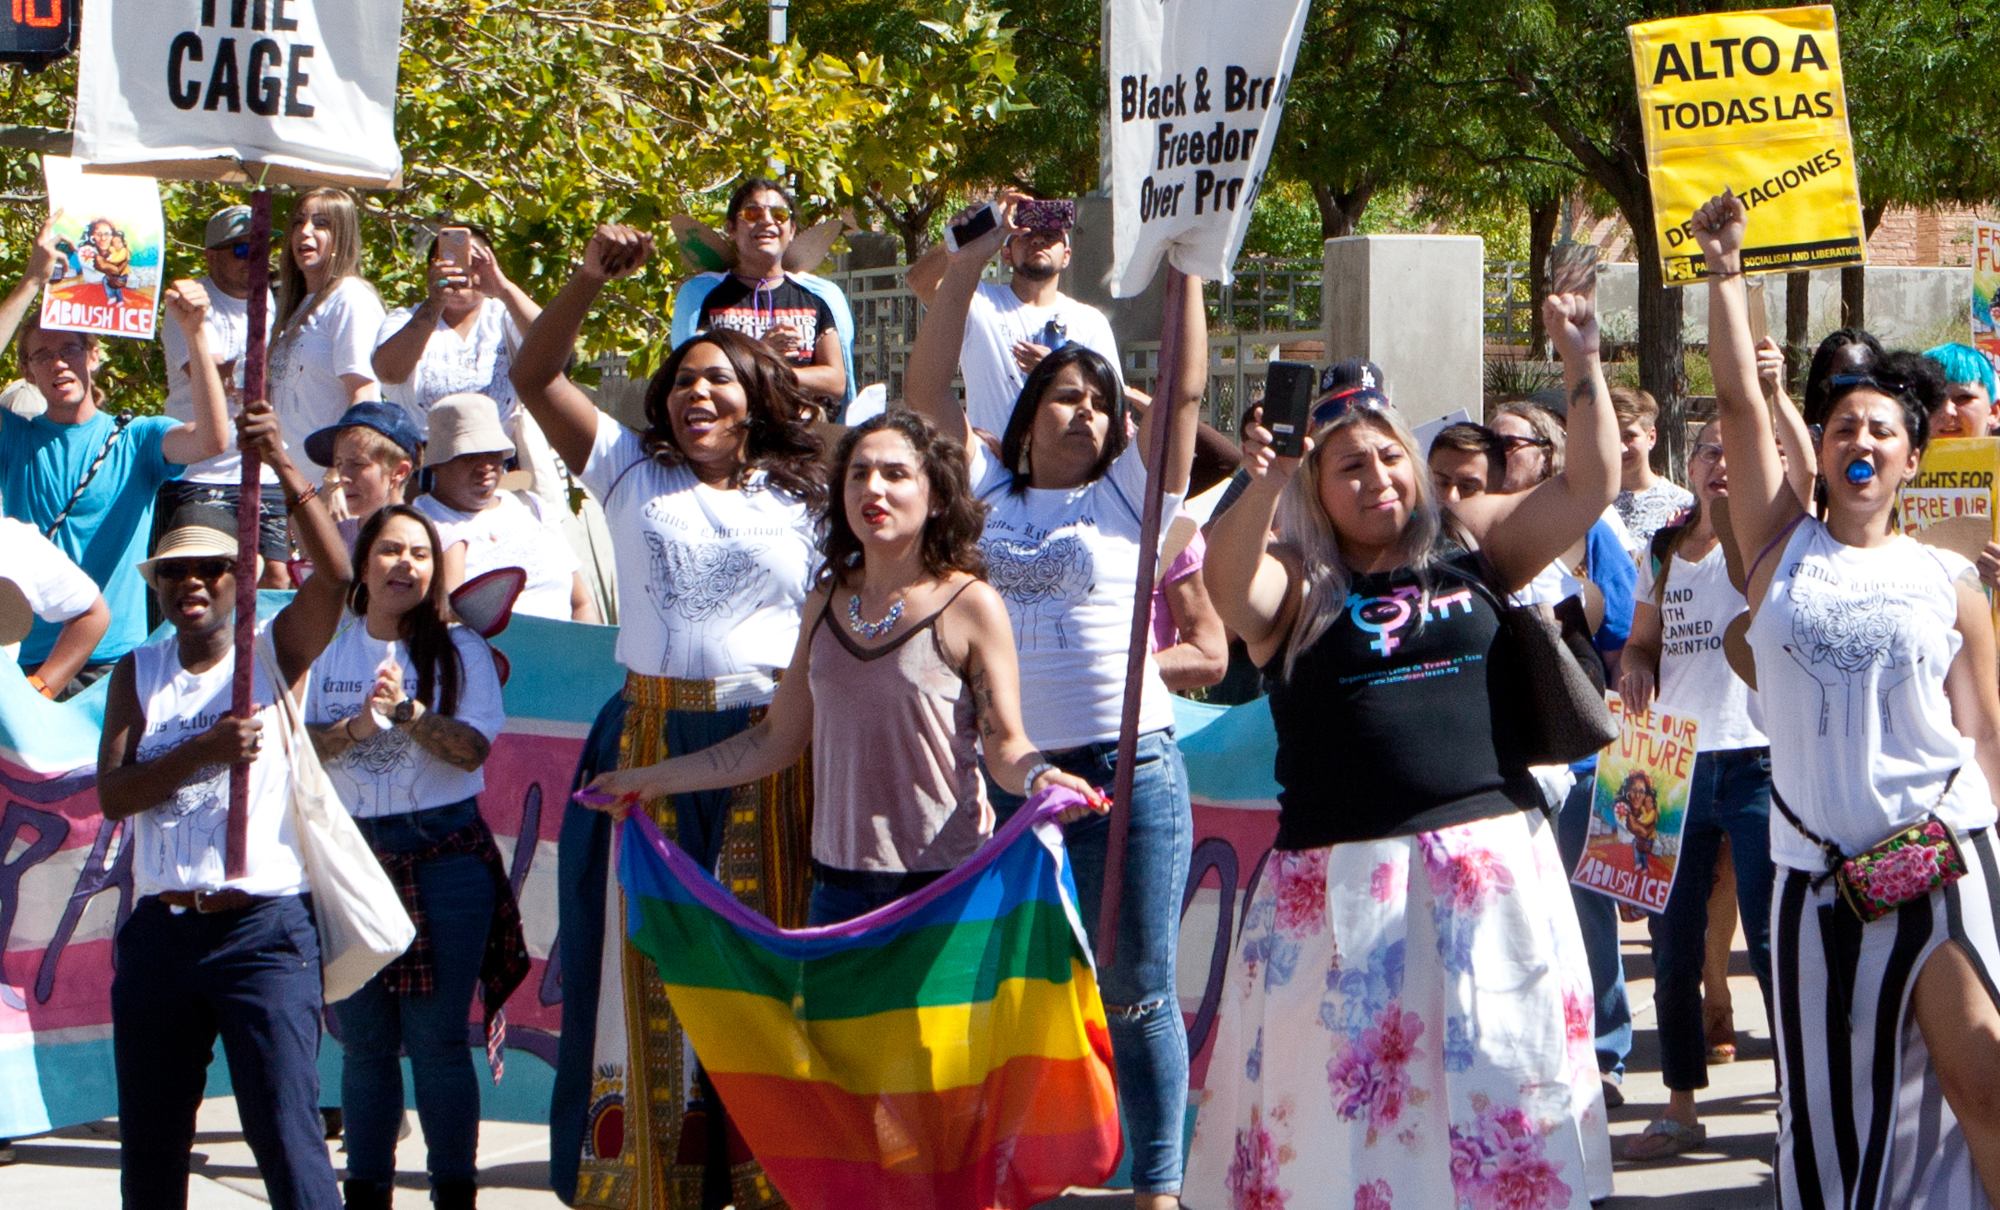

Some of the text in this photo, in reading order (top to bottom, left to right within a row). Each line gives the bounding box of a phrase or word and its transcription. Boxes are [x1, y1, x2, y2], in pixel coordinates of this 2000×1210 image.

[167, 31, 315, 117] CAGE
[1653, 34, 1829, 84] ALTO A
[1121, 74, 1187, 123] Black
[1194, 66, 1211, 114] &
[1655, 92, 1834, 130] TODAS LAS
[1140, 176, 1185, 223] Over
[1665, 149, 1842, 248] DETACIONES
[1667, 261, 1696, 281] PSL
[1743, 245, 1861, 267] SOCIALISM AND LIBERATION
[45, 300, 152, 333] ABOLISH ICE
[1961, 471, 1993, 490] FOR
[645, 502, 689, 531] Trans
[1903, 496, 1987, 521] FREE OUR
[1423, 660, 1451, 670] Trans
[1662, 714, 1697, 747] OUR
[1576, 857, 1669, 907] ABOLISH ICE
